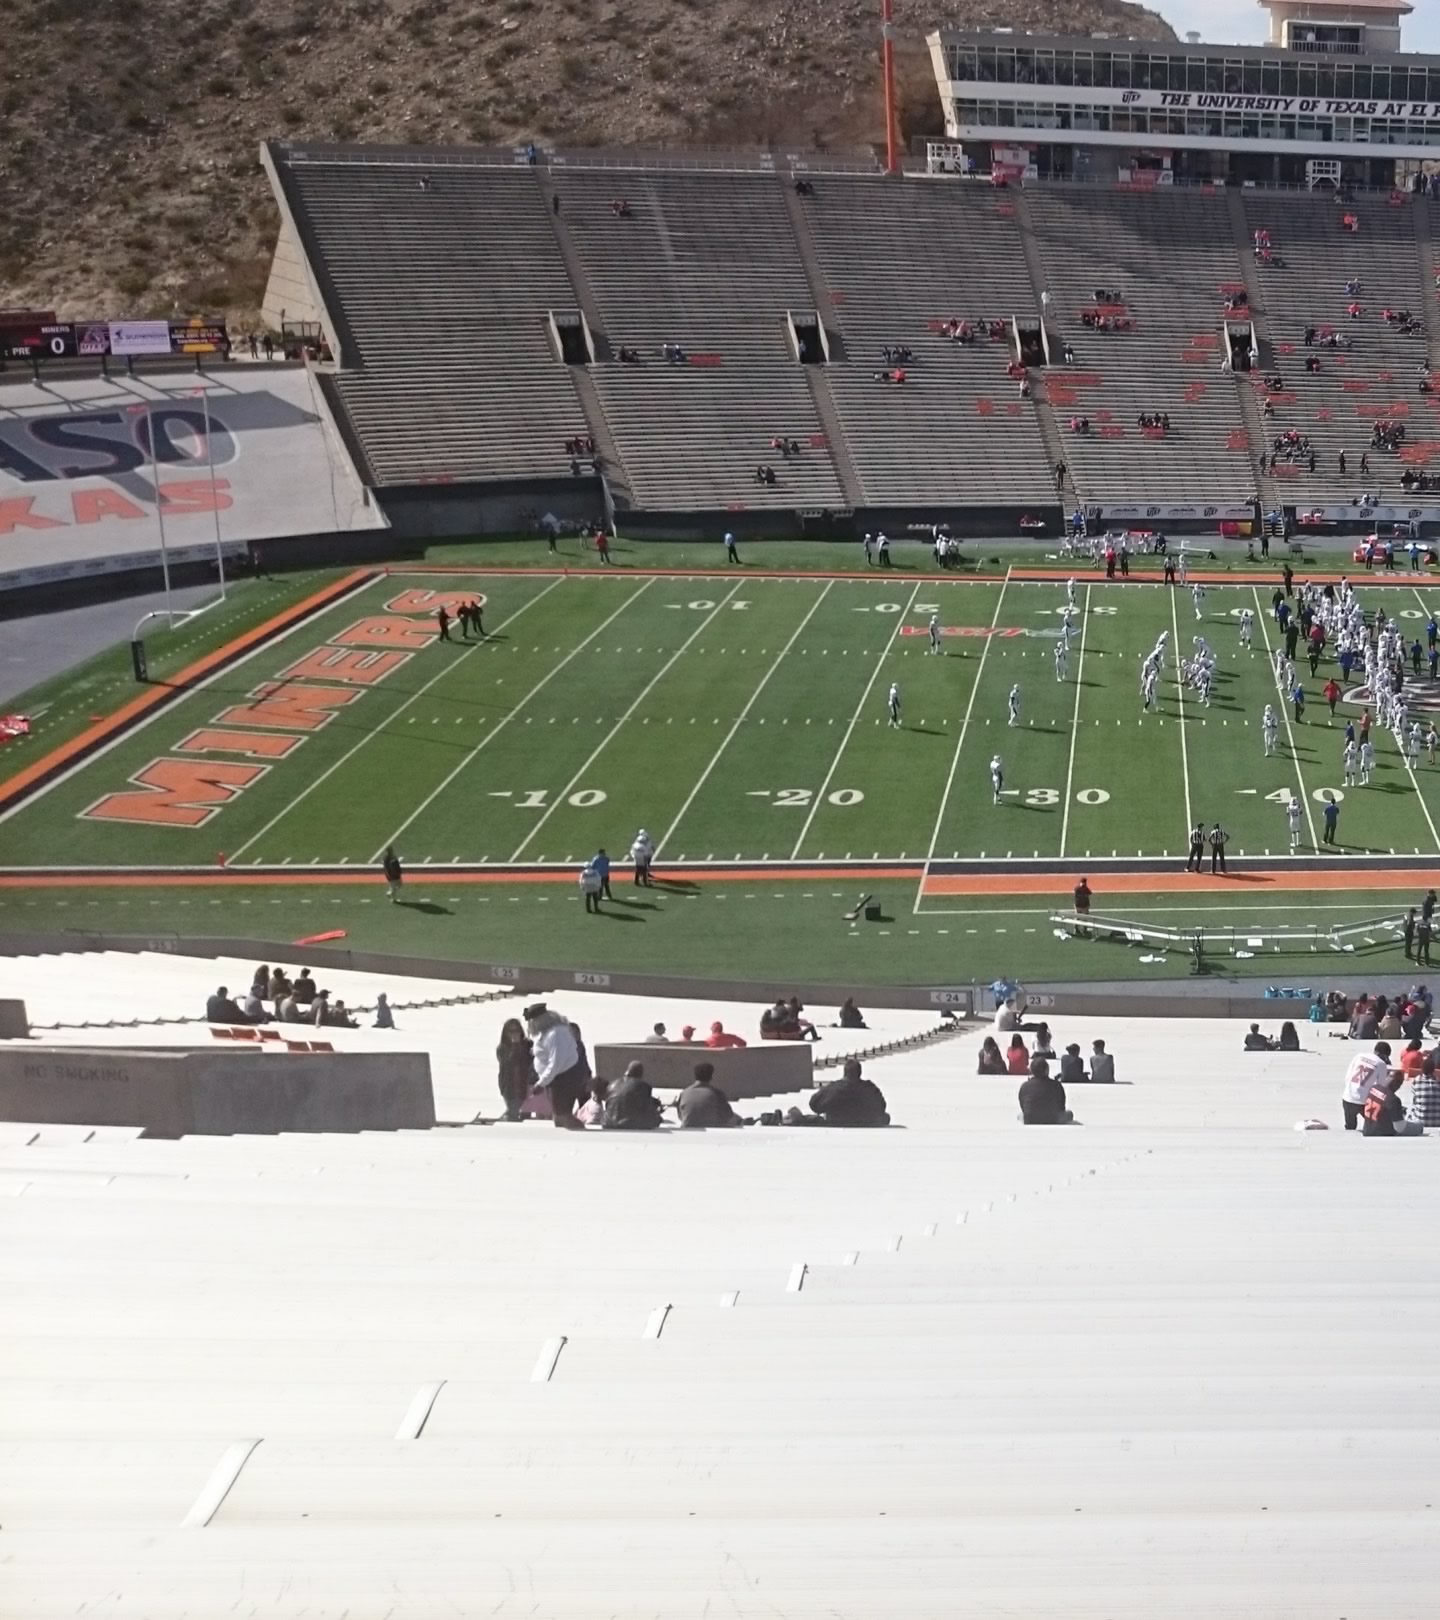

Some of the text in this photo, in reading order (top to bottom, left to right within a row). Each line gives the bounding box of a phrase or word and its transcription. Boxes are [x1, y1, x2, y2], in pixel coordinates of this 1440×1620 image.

[1160, 92, 1191, 107] THE
[1196, 93, 1297, 112] UNIVERSITY
[1299, 99, 1320, 113] OF
[1325, 100, 1378, 115] TEXAS
[1382, 102, 1403, 116] AT
[1409, 104, 1428, 117] EL
[41, 326, 70, 334] MINERS
[12, 346, 31, 356] PRE
[51, 337, 65, 354] 0
[76, 588, 488, 827] MINERS
[515, 788, 607, 808] 10
[771, 788, 865, 807] 20
[1024, 787, 1111, 806] 30
[1264, 786, 1345, 804] 40
[502, 968, 514, 978] 25
[582, 974, 595, 984] 24
[945, 993, 959, 1003] 24
[1029, 995, 1042, 1005] 23
[24, 1066, 130, 1083] NO SMOKING
[1351, 1065, 1375, 1087] 27
